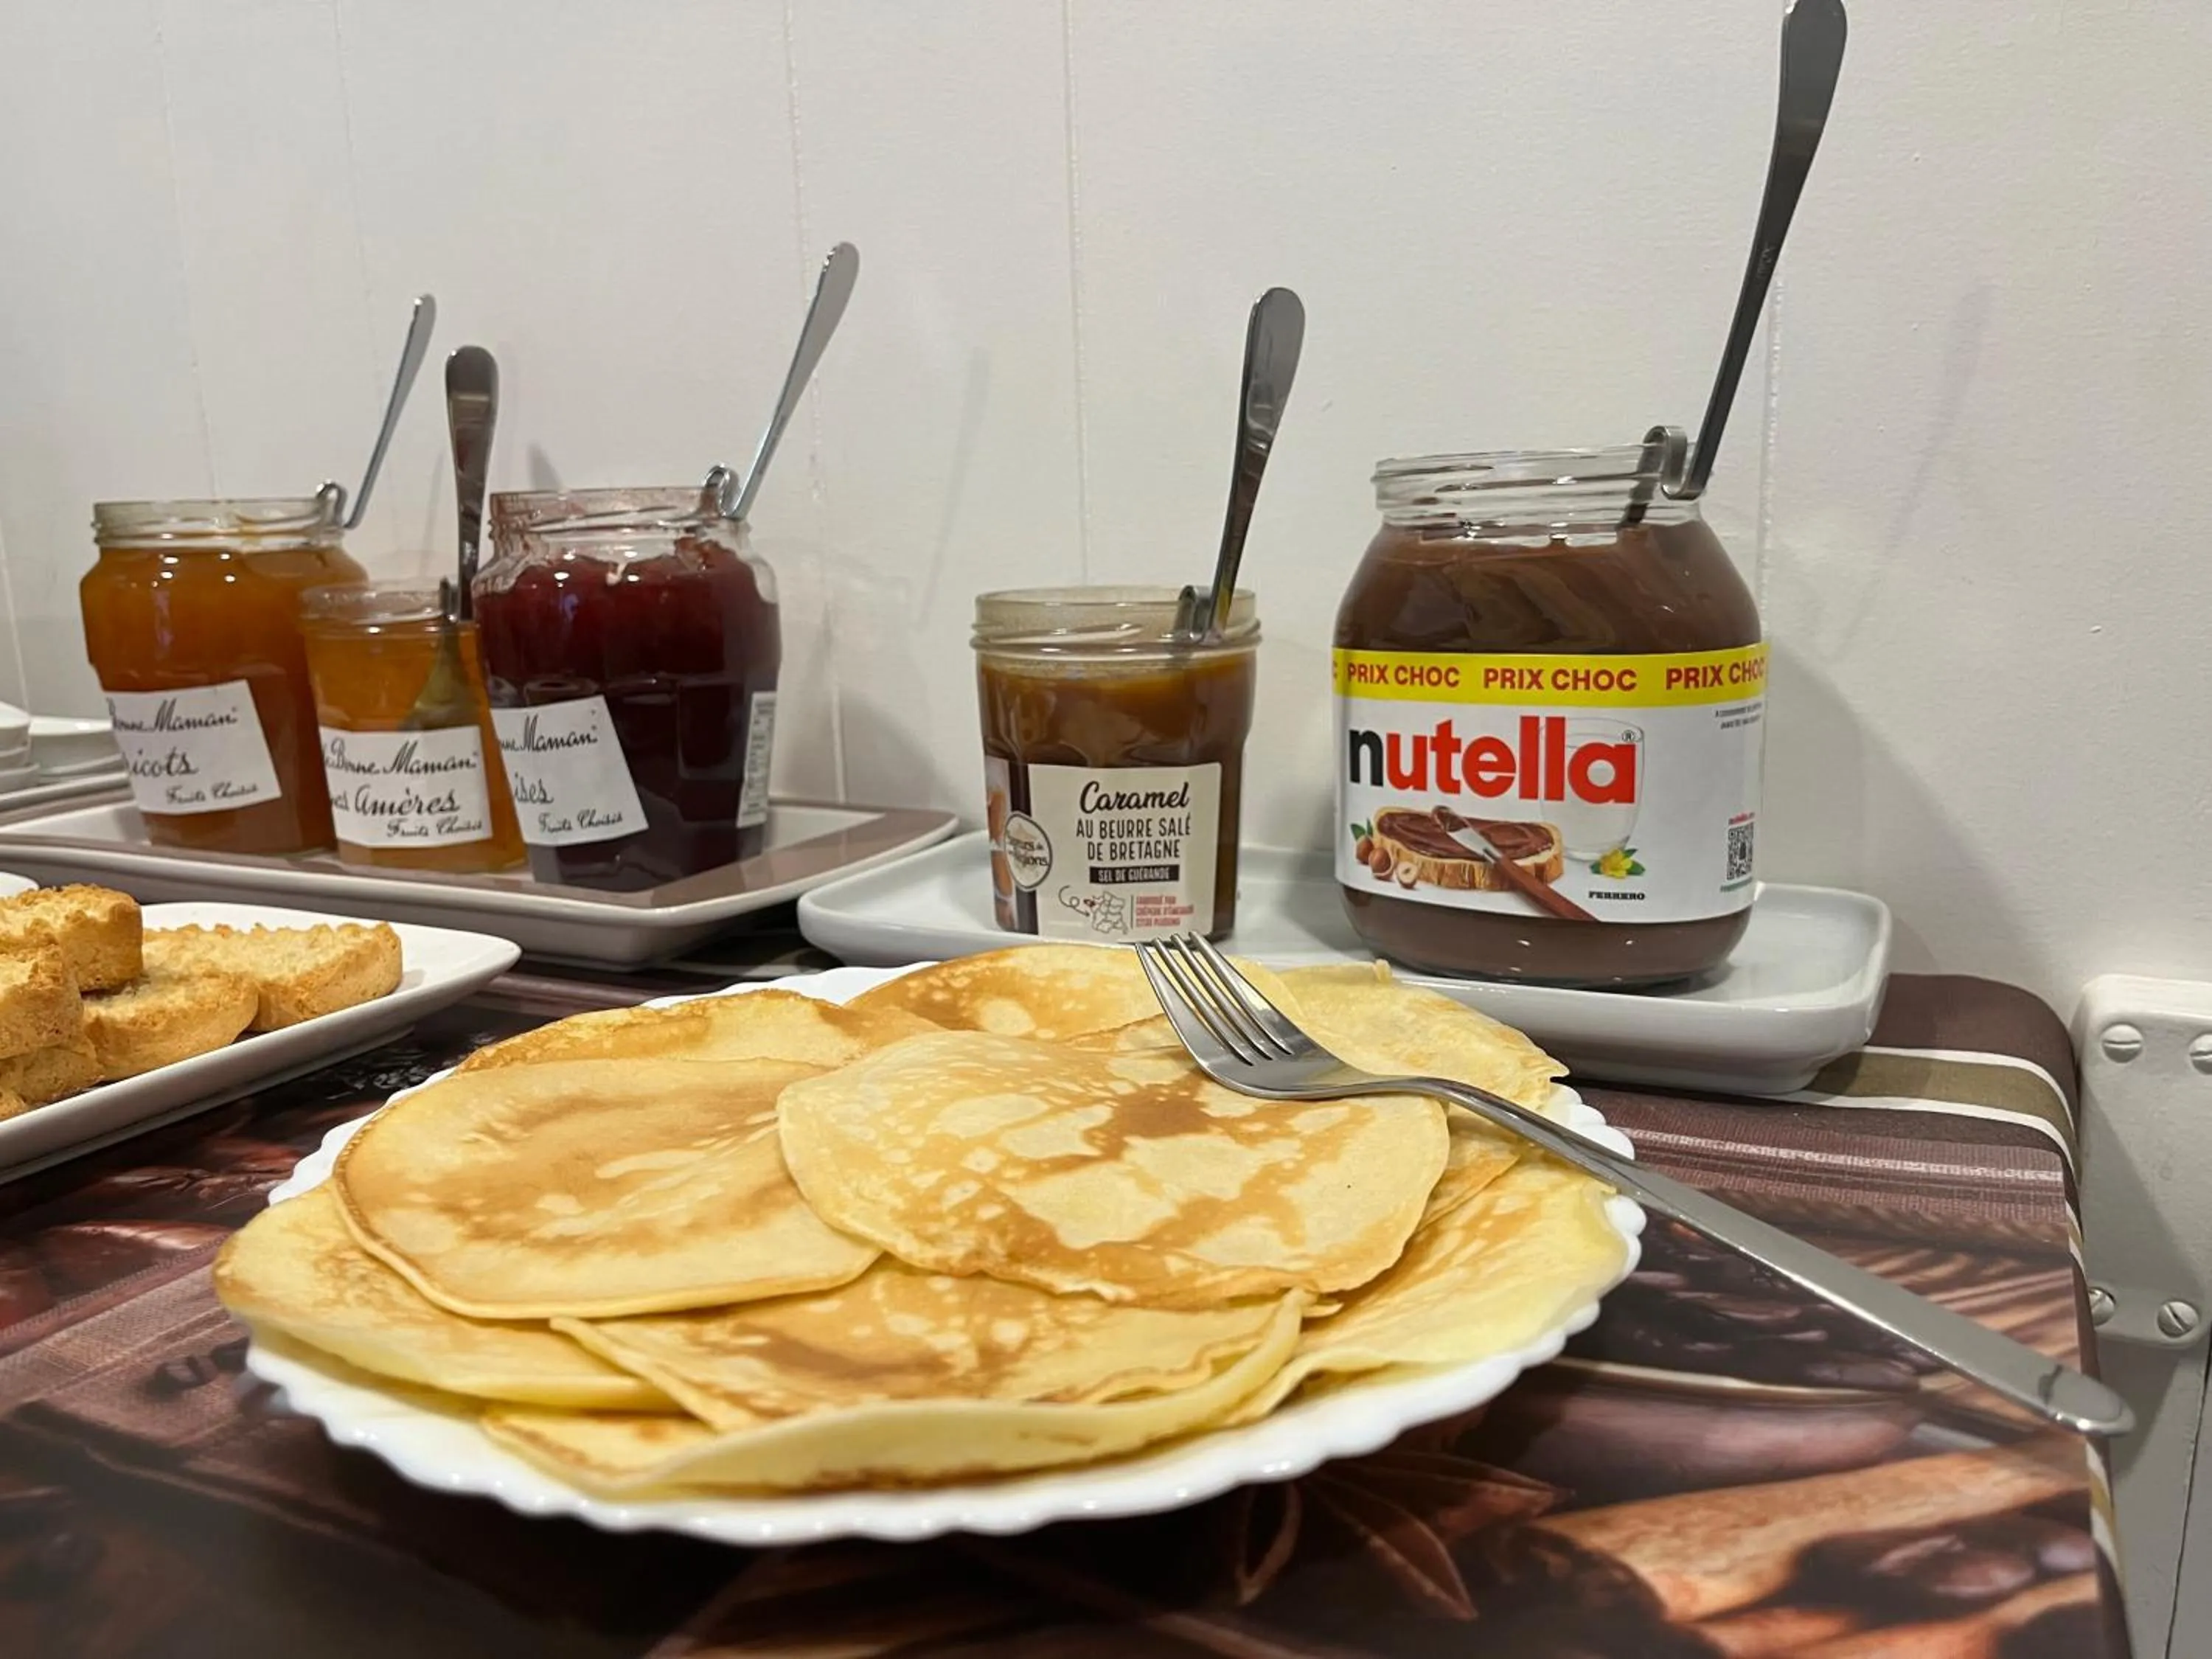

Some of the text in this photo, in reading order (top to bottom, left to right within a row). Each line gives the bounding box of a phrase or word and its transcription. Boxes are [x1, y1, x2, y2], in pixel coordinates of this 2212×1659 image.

[1347, 662, 1388, 685] PRIX
[1394, 665, 1460, 688] CHOC
[1484, 667, 1637, 692] PRIX CHOC
[1666, 665, 1724, 689] PRIX
[122, 746, 200, 777] icots
[1349, 715, 1636, 804] nutella
[515, 772, 554, 804] ises
[1079, 781, 1191, 814] Caramel
[1076, 812, 1191, 839] AU BEURRE SALÉ
[1088, 839, 1180, 861] DE BRETAGNE
[1098, 869, 1113, 883] SEL
[1115, 869, 1126, 882] DE
[1588, 891, 1645, 900] FERRERO
